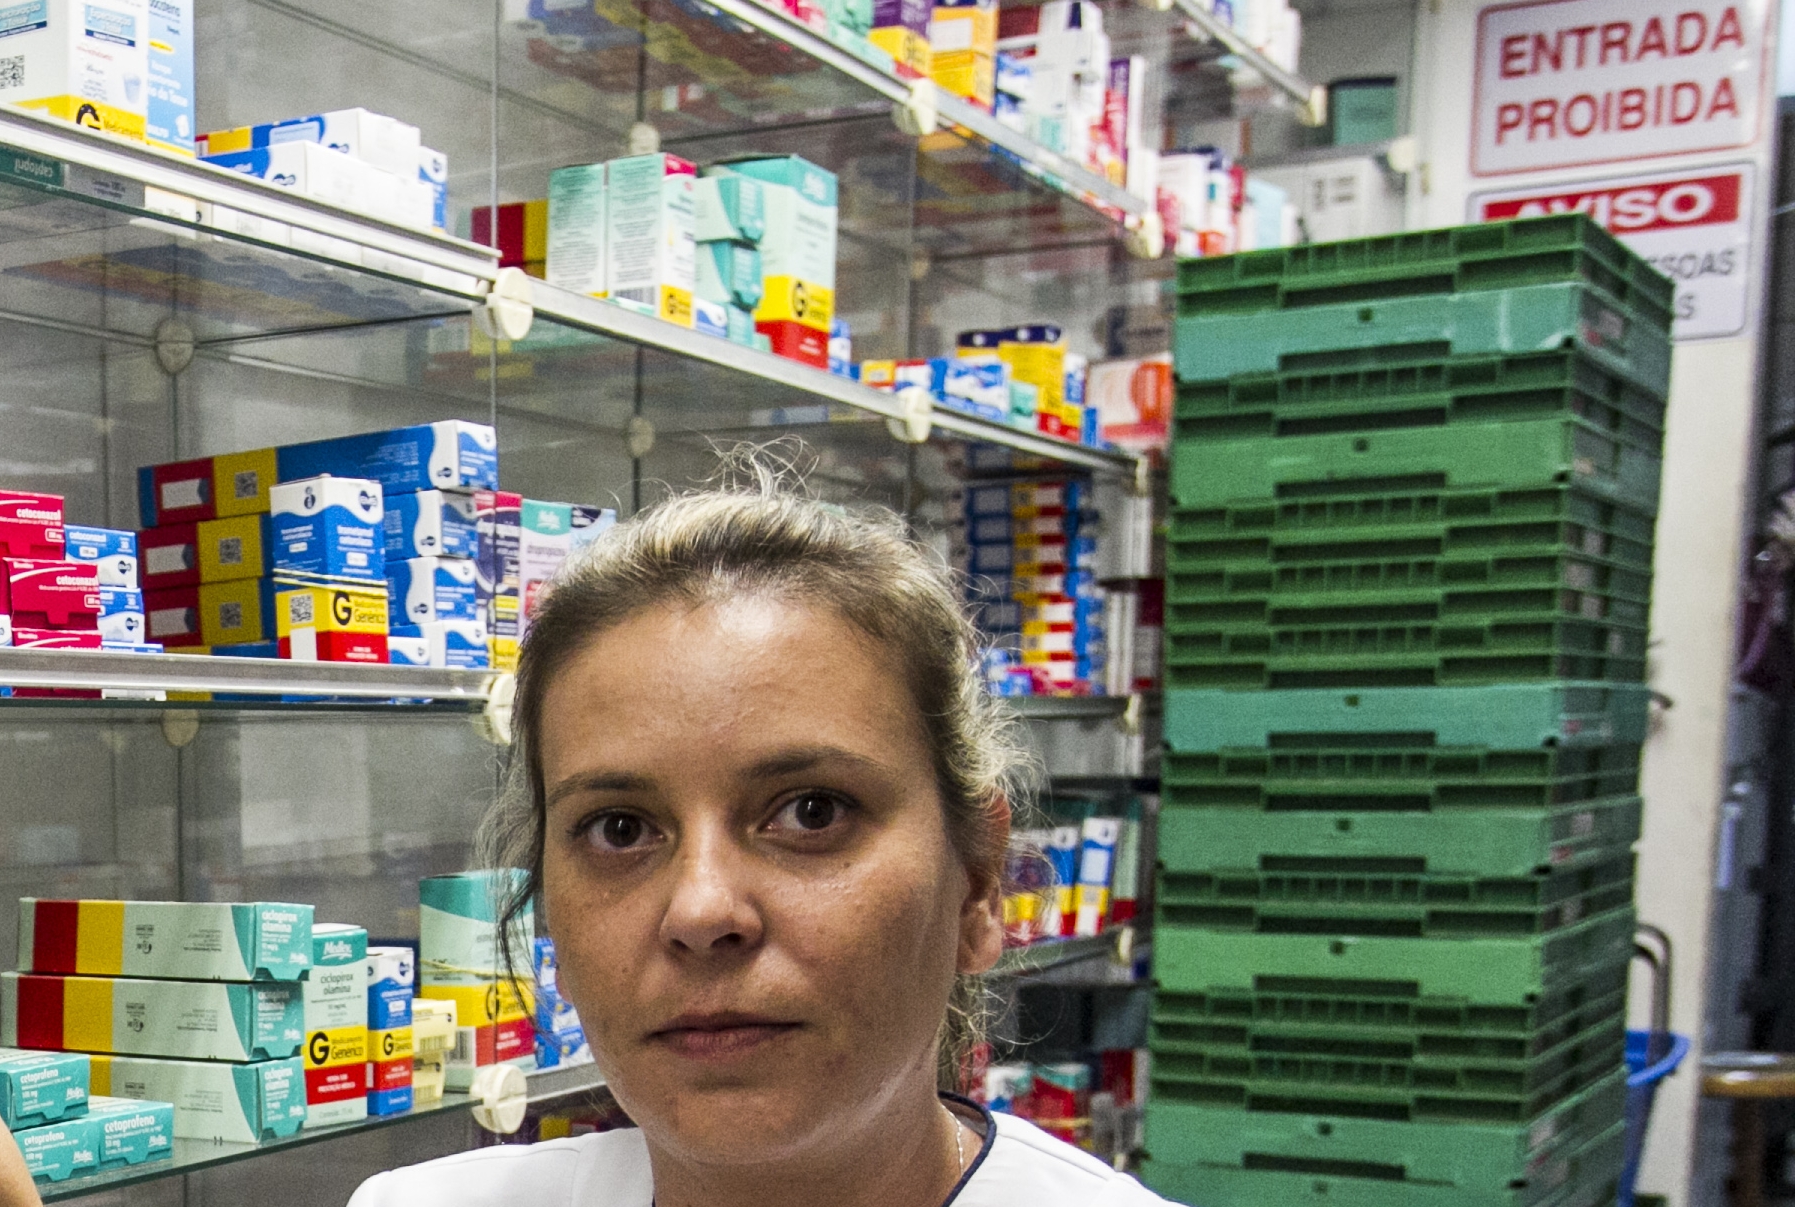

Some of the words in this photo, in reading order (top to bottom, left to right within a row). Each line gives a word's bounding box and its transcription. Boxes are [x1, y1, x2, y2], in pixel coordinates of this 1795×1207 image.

[1499, 6, 1744, 80] ENTRADA
[1495, 77, 1739, 146] PROIBIDA
[16, 508, 61, 520] cetoconazol
[56, 575, 99, 586] cetoconazol
[333, 591, 351, 625] G
[321, 941, 352, 960] Medley
[320, 972, 353, 986] ciclopirox
[323, 984, 351, 996] olamina
[309, 1032, 329, 1065] G
[331, 1045, 364, 1060] Genérico
[383, 1033, 394, 1055] G
[20, 1068, 58, 1084] cetoprofeno
[104, 1114, 155, 1133] cetoprofeno
[24, 1131, 65, 1147] cetoprofeno
